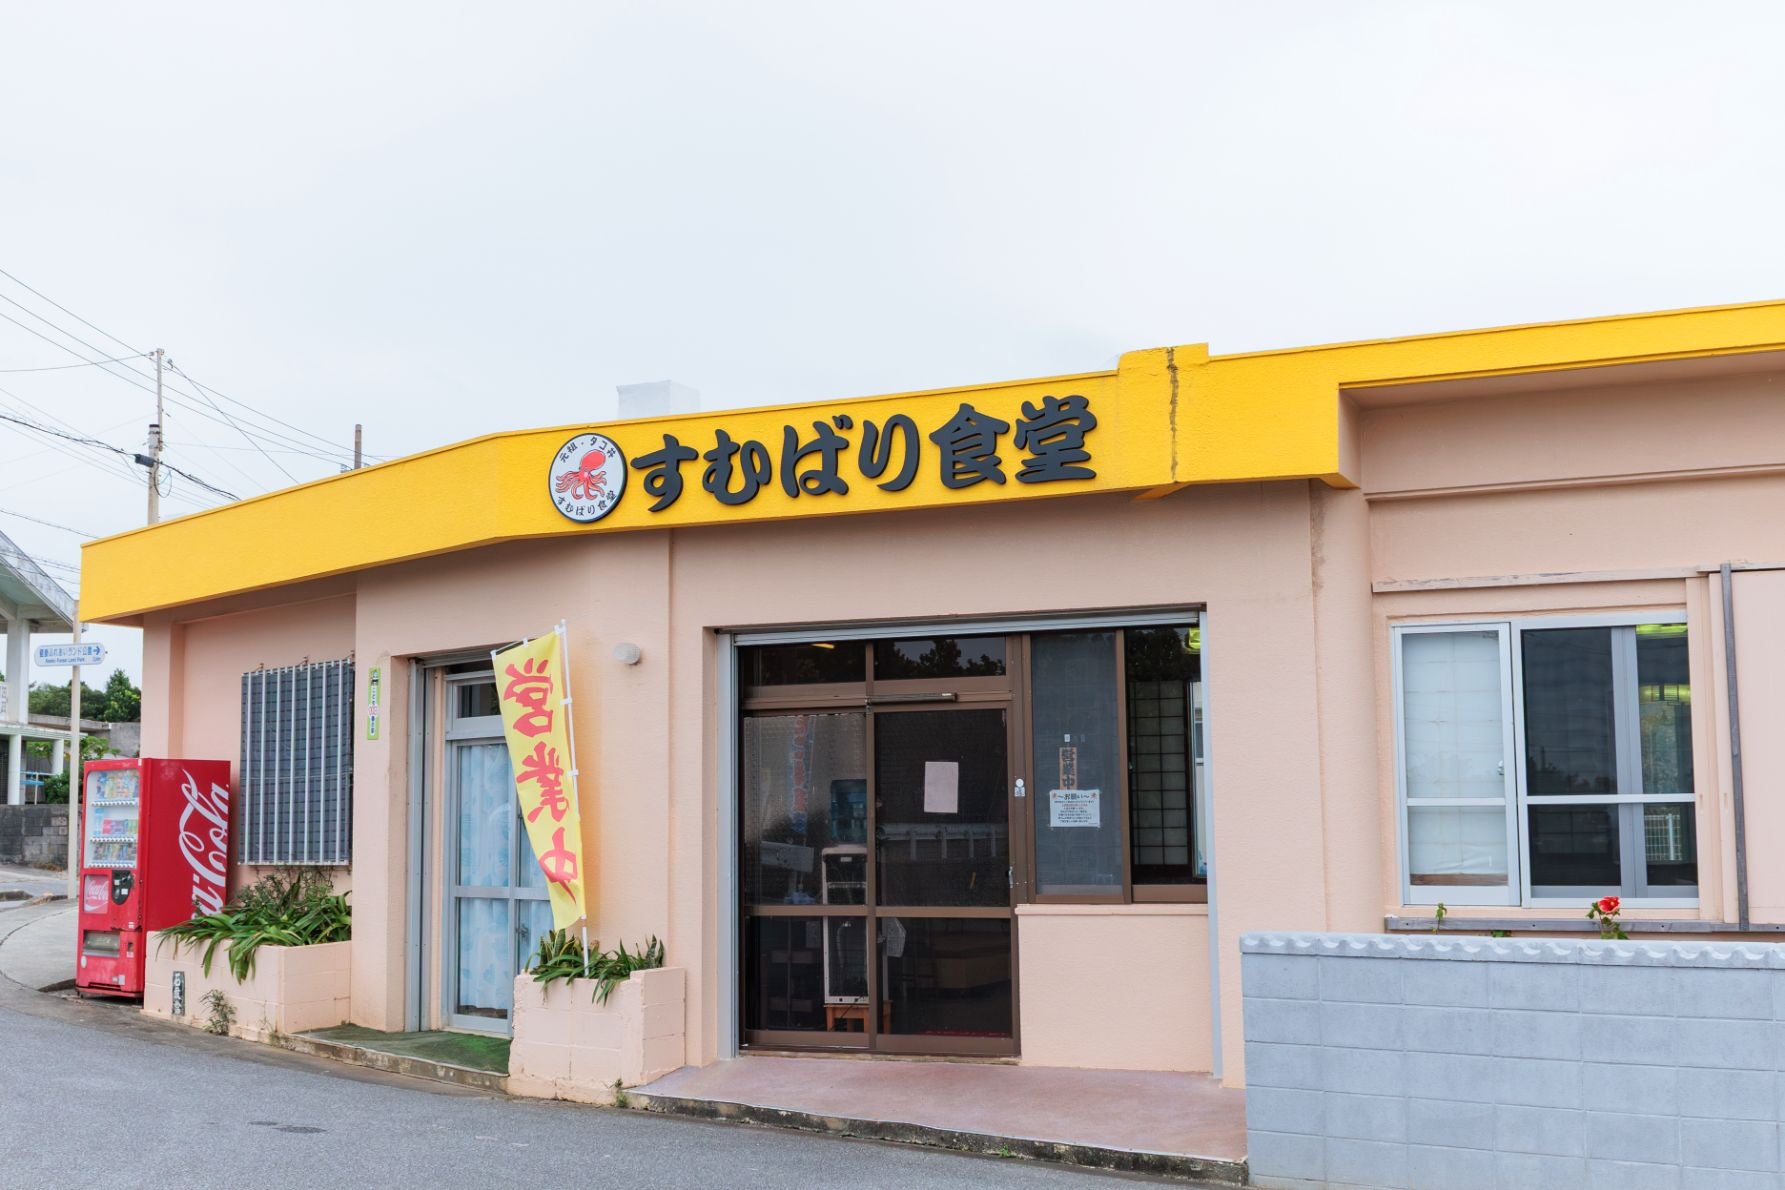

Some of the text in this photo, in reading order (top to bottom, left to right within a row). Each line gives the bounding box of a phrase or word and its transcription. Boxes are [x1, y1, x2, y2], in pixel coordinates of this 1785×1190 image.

[557, 490, 617, 516] すむばり食堂
[630, 395, 1097, 512] すむばり食堂
[178, 769, 230, 920] a-Cola
